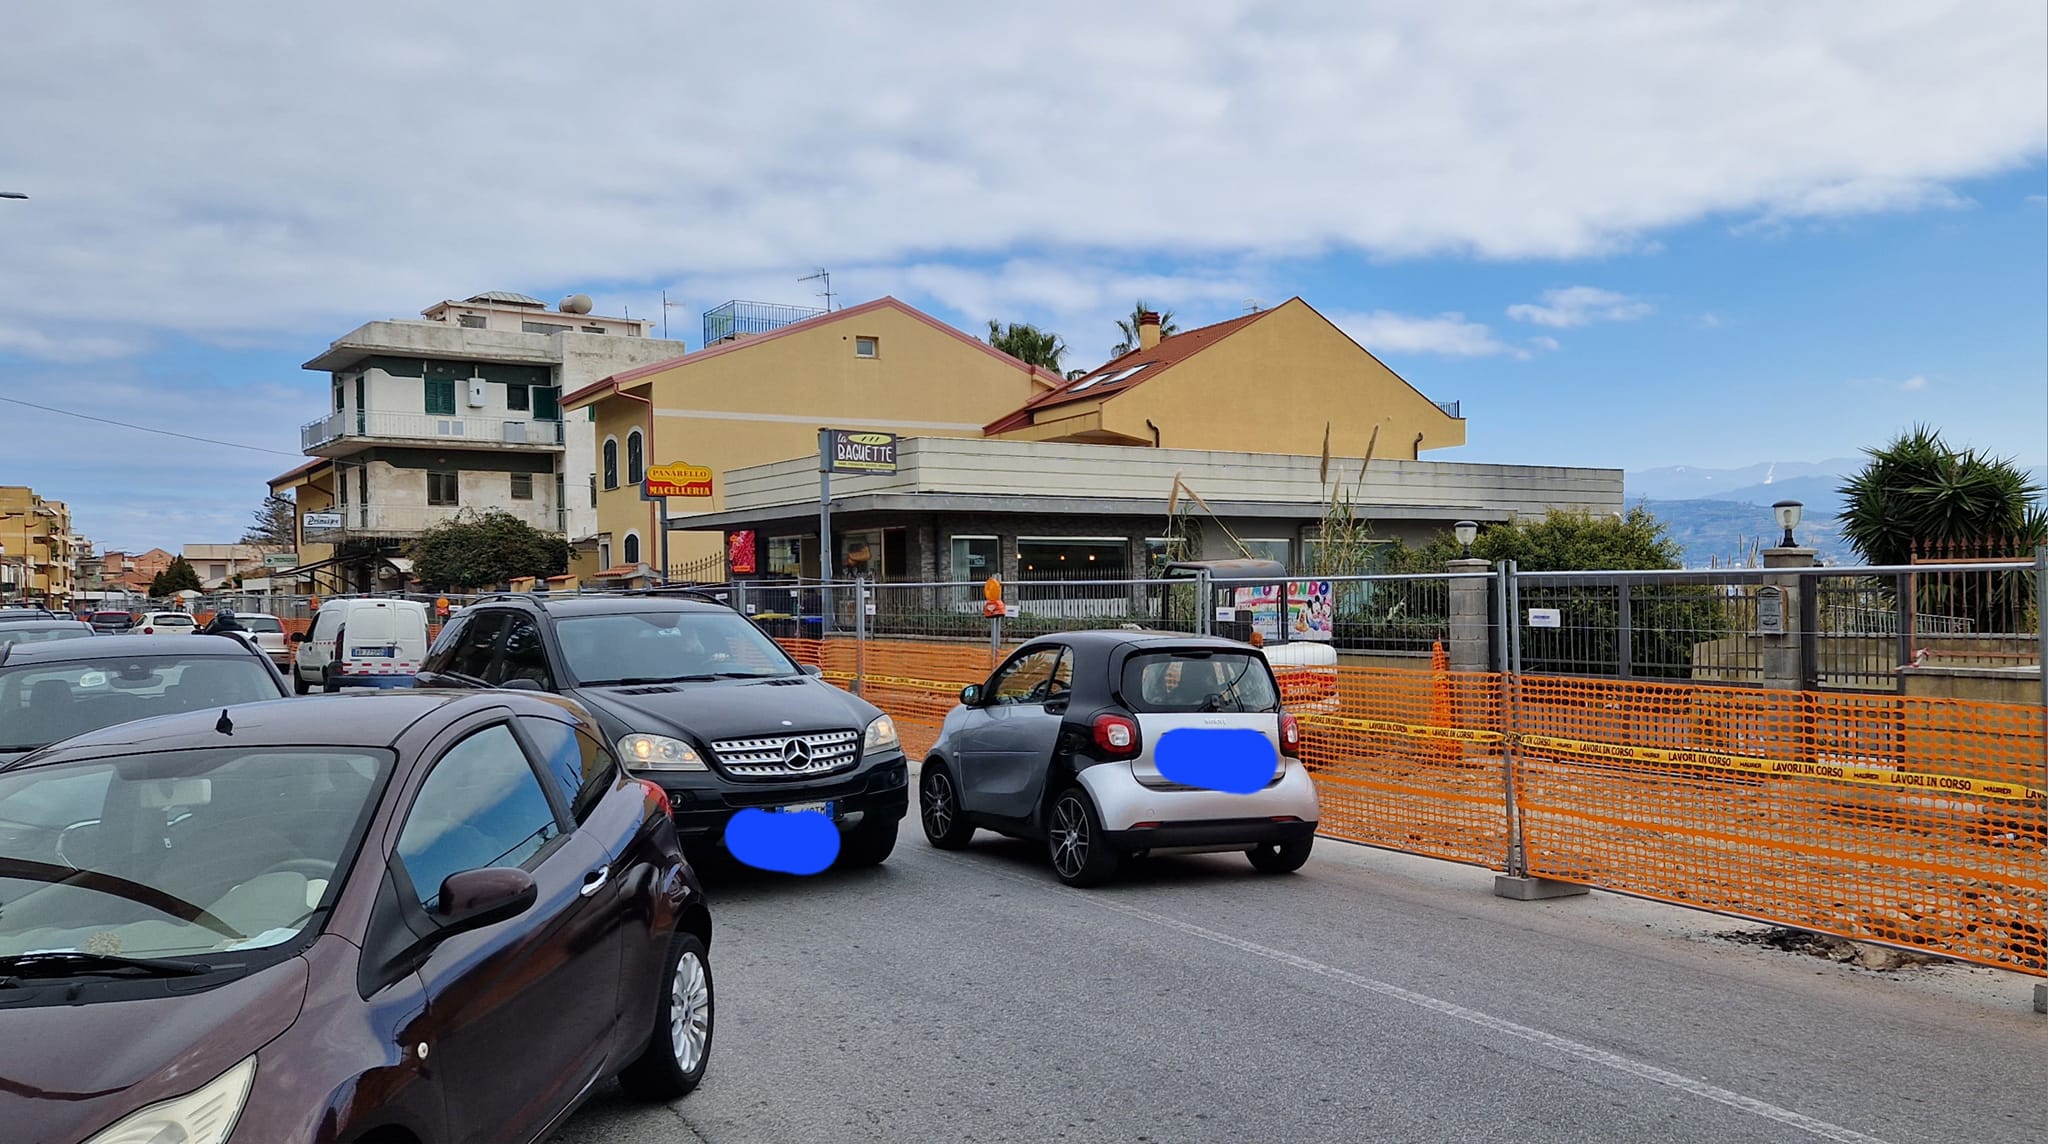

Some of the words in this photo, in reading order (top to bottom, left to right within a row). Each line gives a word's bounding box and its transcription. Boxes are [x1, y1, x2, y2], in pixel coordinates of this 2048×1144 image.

[837, 443, 893, 462] BAGUETTE
[649, 486, 710, 496] MACELLERIA
[1580, 743, 1602, 753] LAVORI
[1603, 745, 1610, 754] IN
[1611, 746, 1634, 757] CORSO
[1668, 752, 1696, 763] LAVORI
[1698, 755, 1707, 764] IN
[1708, 756, 1731, 767] CORSO
[1772, 762, 1802, 773] LAVORI
[1804, 765, 1814, 774] IN
[1816, 765, 1843, 778] CORSO
[1890, 774, 1924, 786] LAVORI
[1926, 776, 1937, 787] IN
[1940, 777, 1971, 791] CORSO
[2025, 788, 2048, 799] LAV
